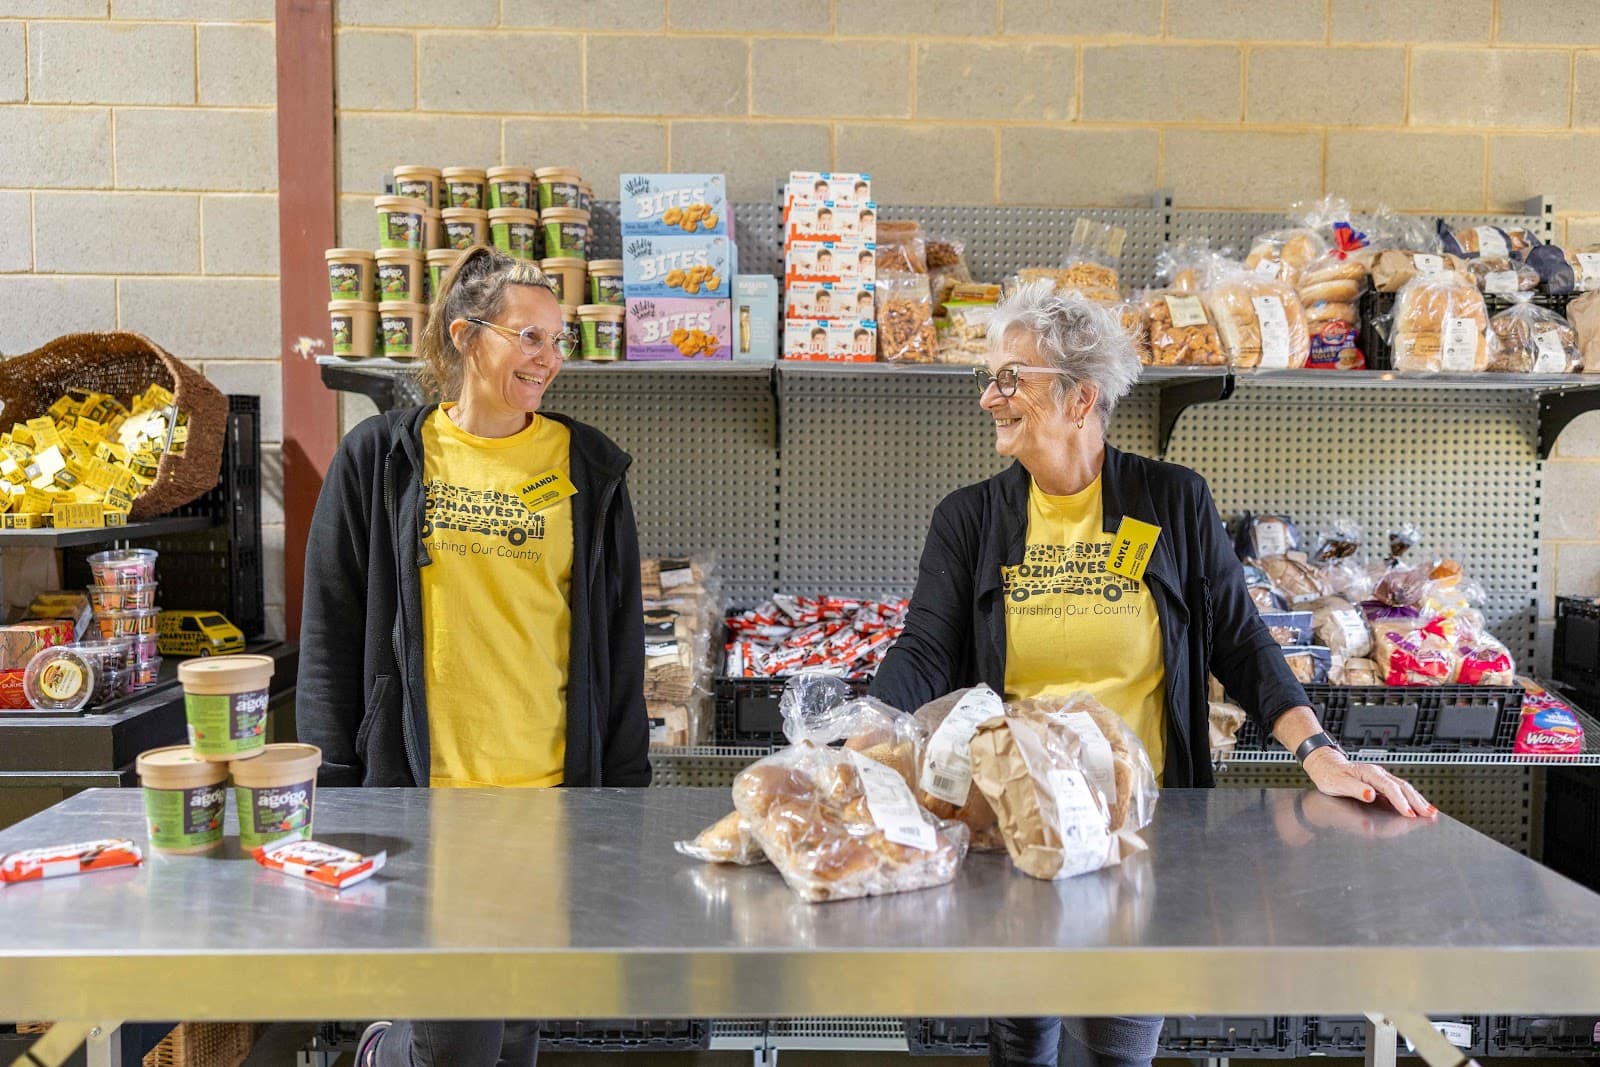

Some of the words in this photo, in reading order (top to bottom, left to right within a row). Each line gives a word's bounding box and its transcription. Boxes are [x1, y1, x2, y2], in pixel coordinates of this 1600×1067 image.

[637, 188, 706, 219] BITES
[640, 249, 709, 281] BITES
[642, 311, 712, 343] BITES
[522, 474, 558, 495] AMANDA
[425, 540, 467, 556] rishing
[471, 542, 494, 554] Our
[497, 545, 542, 563] Country
[1113, 539, 1131, 569] GAYLE
[1017, 561, 1106, 578] OZHARVES
[1066, 604, 1088, 616] Our
[1093, 603, 1142, 616] Country
[258, 789, 306, 809] agogo
